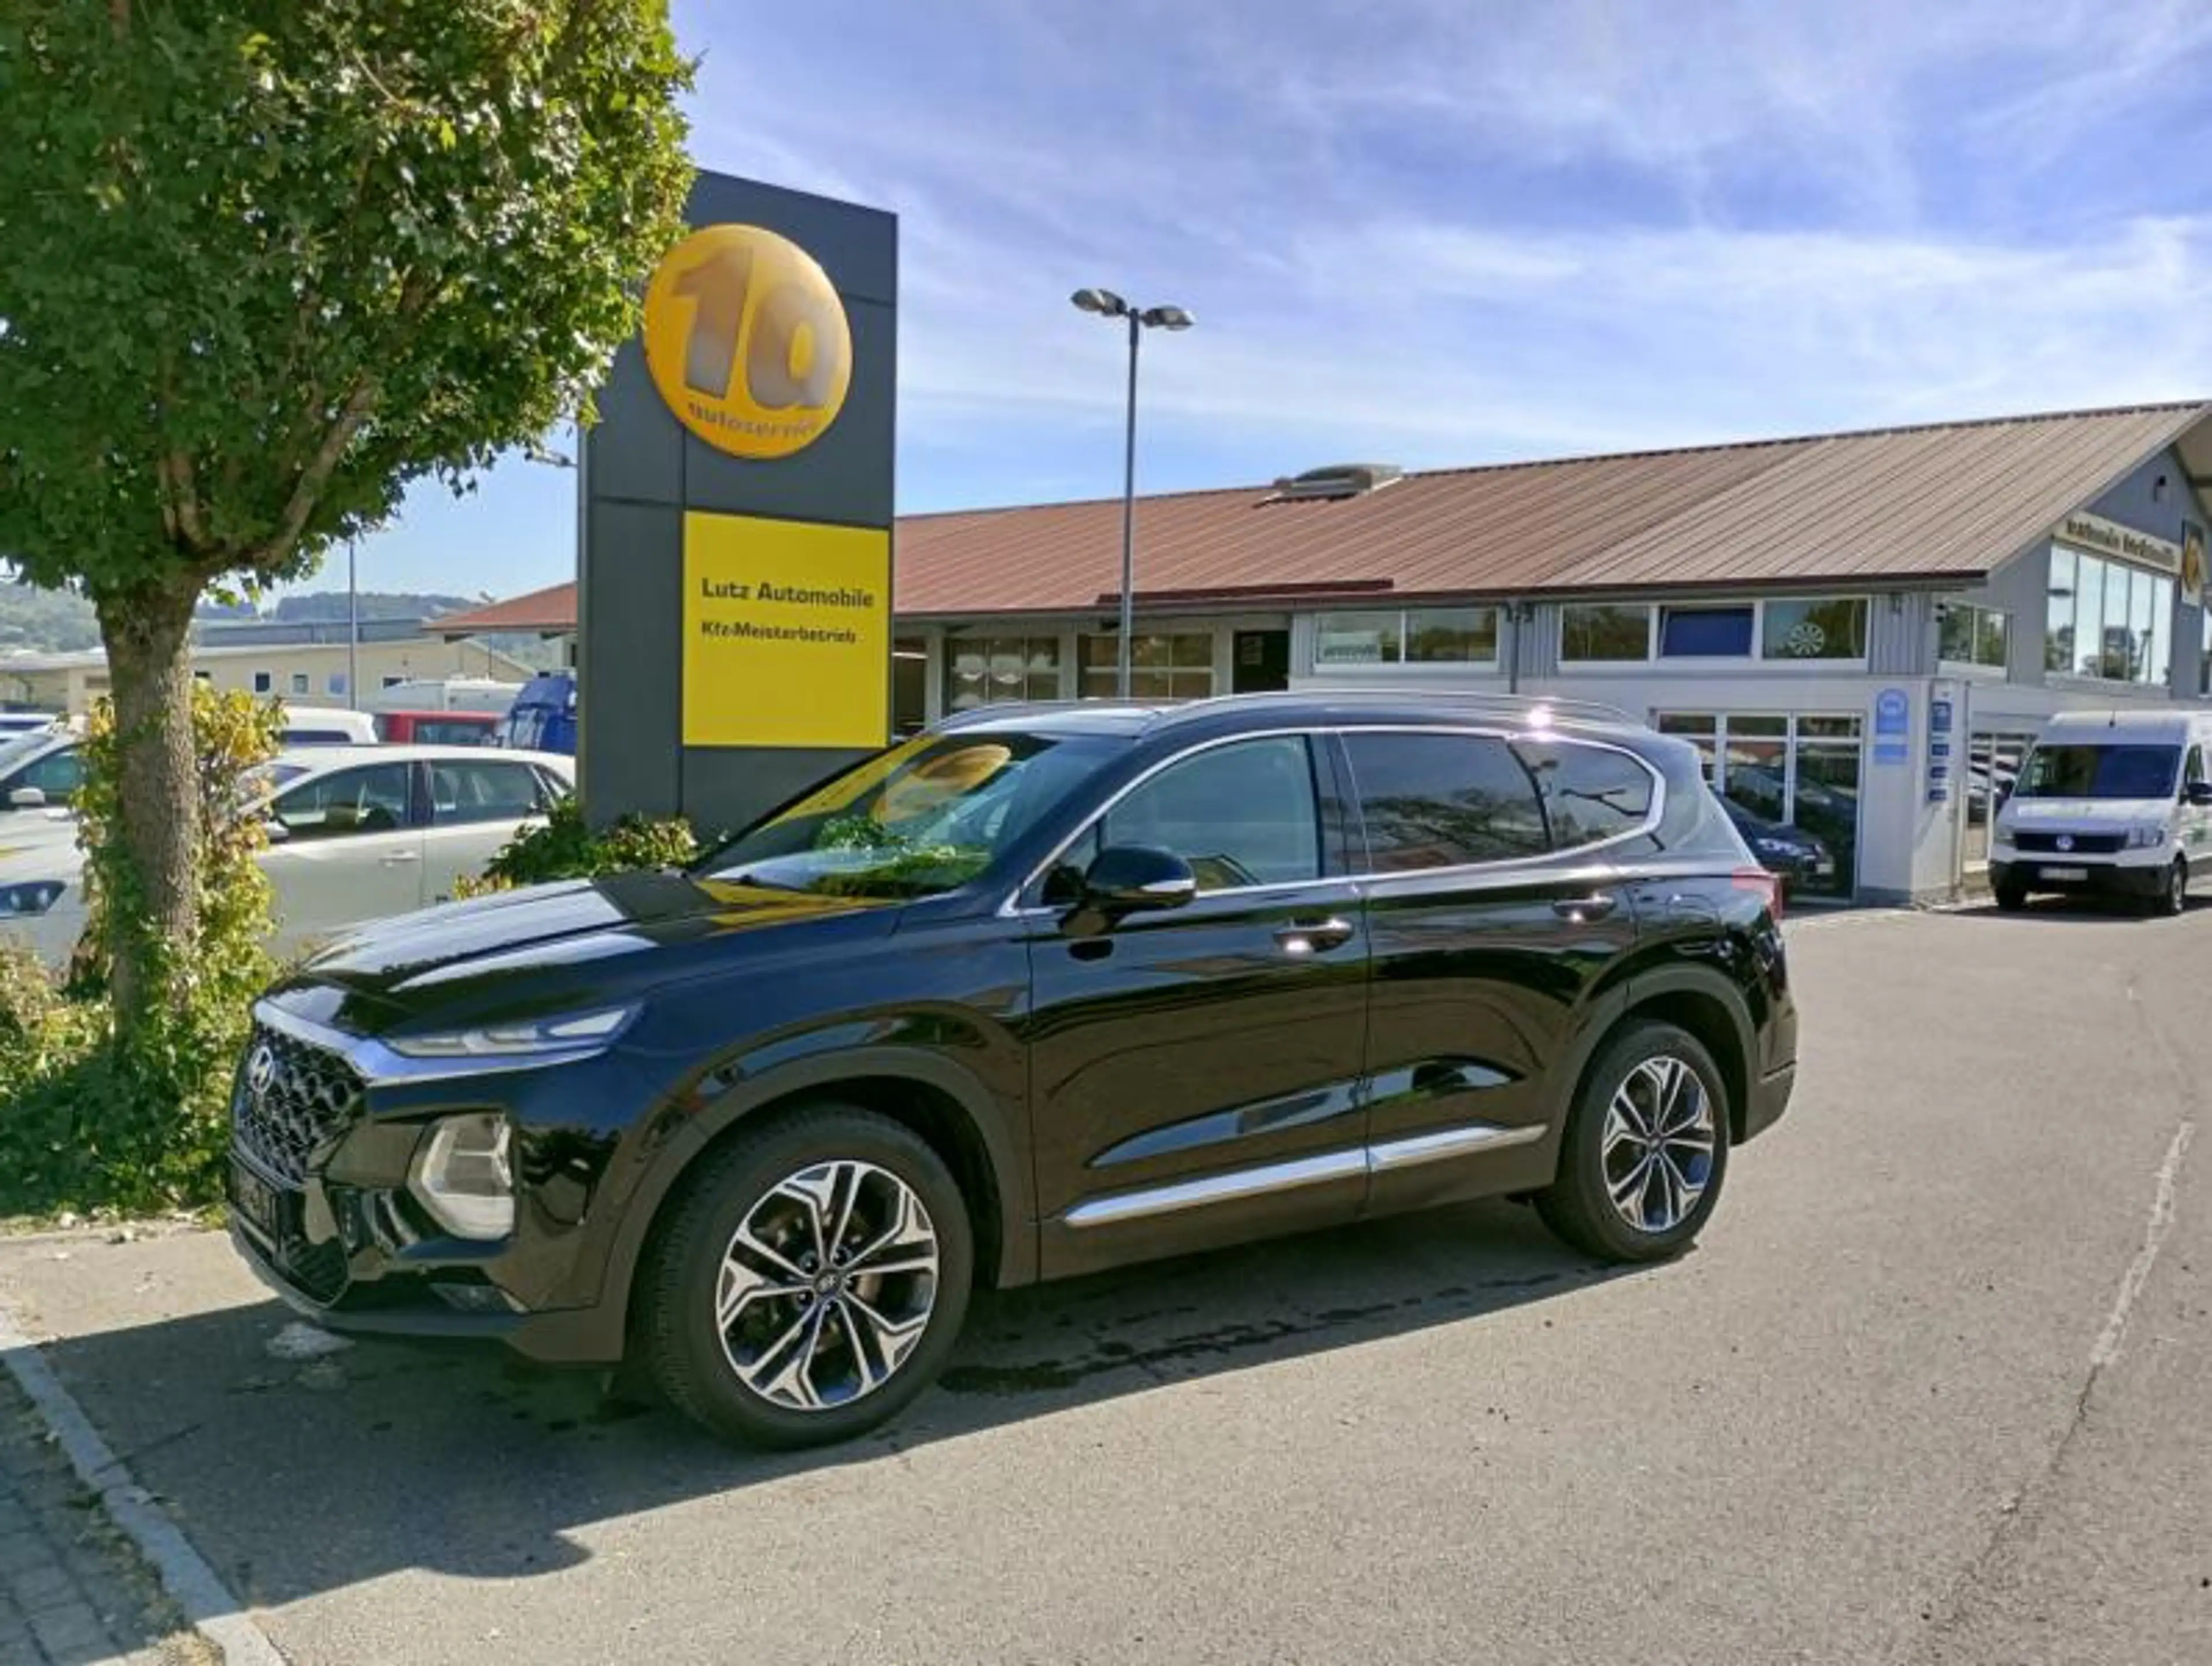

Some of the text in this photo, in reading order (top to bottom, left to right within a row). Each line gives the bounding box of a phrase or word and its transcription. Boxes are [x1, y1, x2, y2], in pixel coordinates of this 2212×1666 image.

[701, 577, 874, 608] Lutz Automobile
[701, 621, 855, 644] Kfz-Meisterbetrieb
